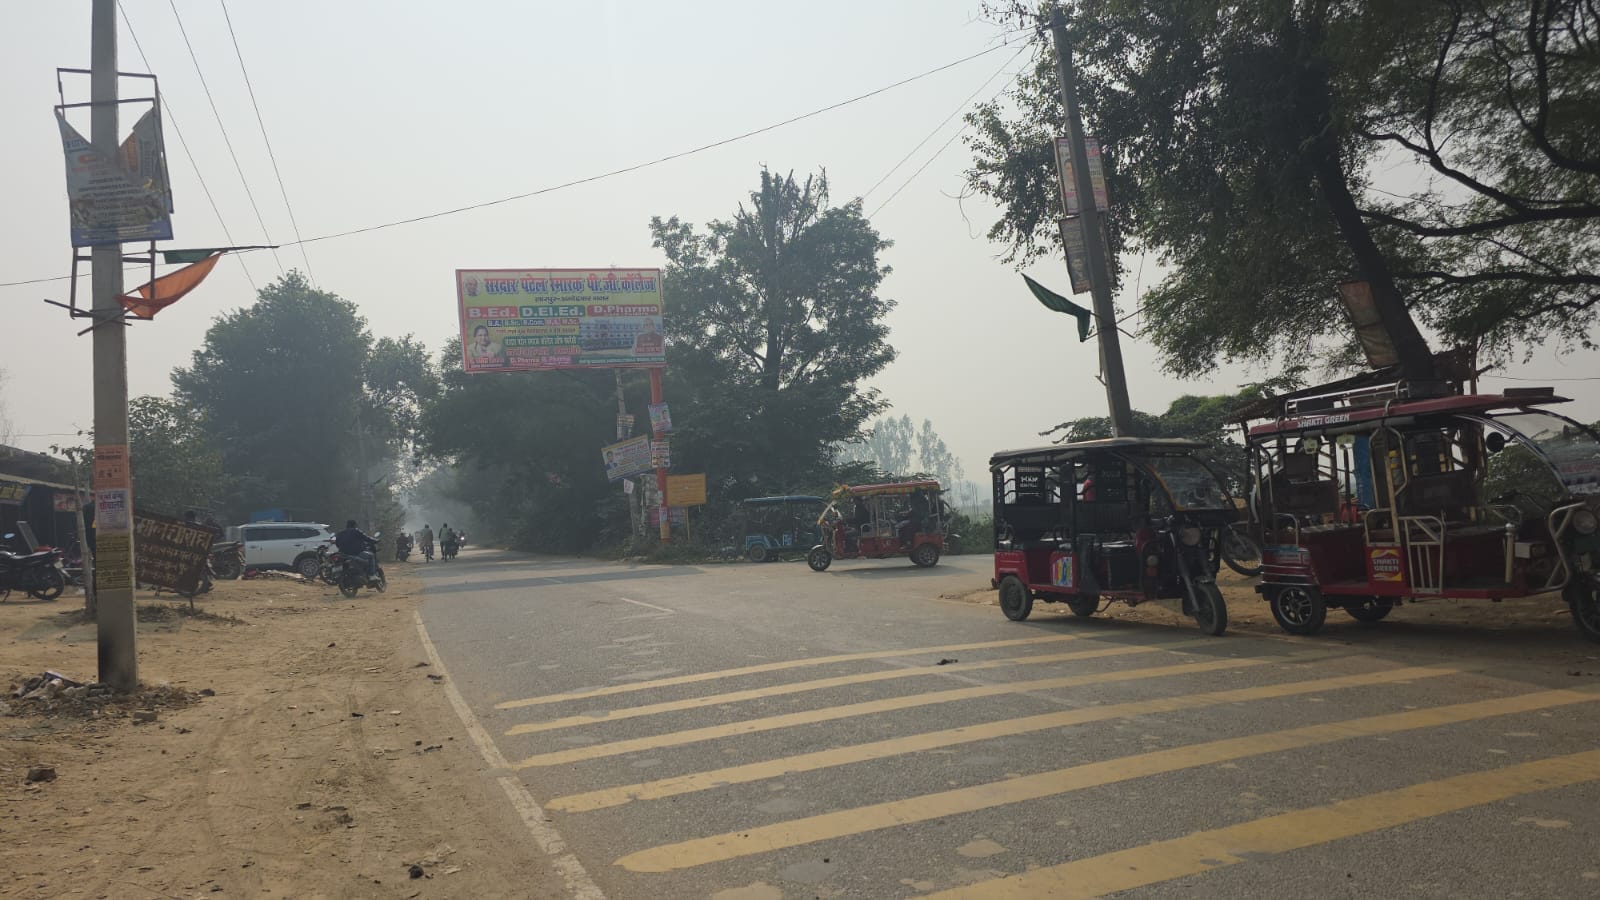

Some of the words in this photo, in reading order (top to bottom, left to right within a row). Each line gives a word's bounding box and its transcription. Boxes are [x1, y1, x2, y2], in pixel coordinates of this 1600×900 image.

[484, 277, 518, 294] सरदार
[520, 273, 547, 294] पटेल
[549, 277, 584, 292] स्मारक
[468, 307, 516, 317] B.Ed.
[522, 305, 584, 317] D.El.Ed.
[593, 305, 658, 314] D.Pharma
[1297, 417, 1323, 428] SHAKTI
[1324, 413, 1350, 424] GREEN
